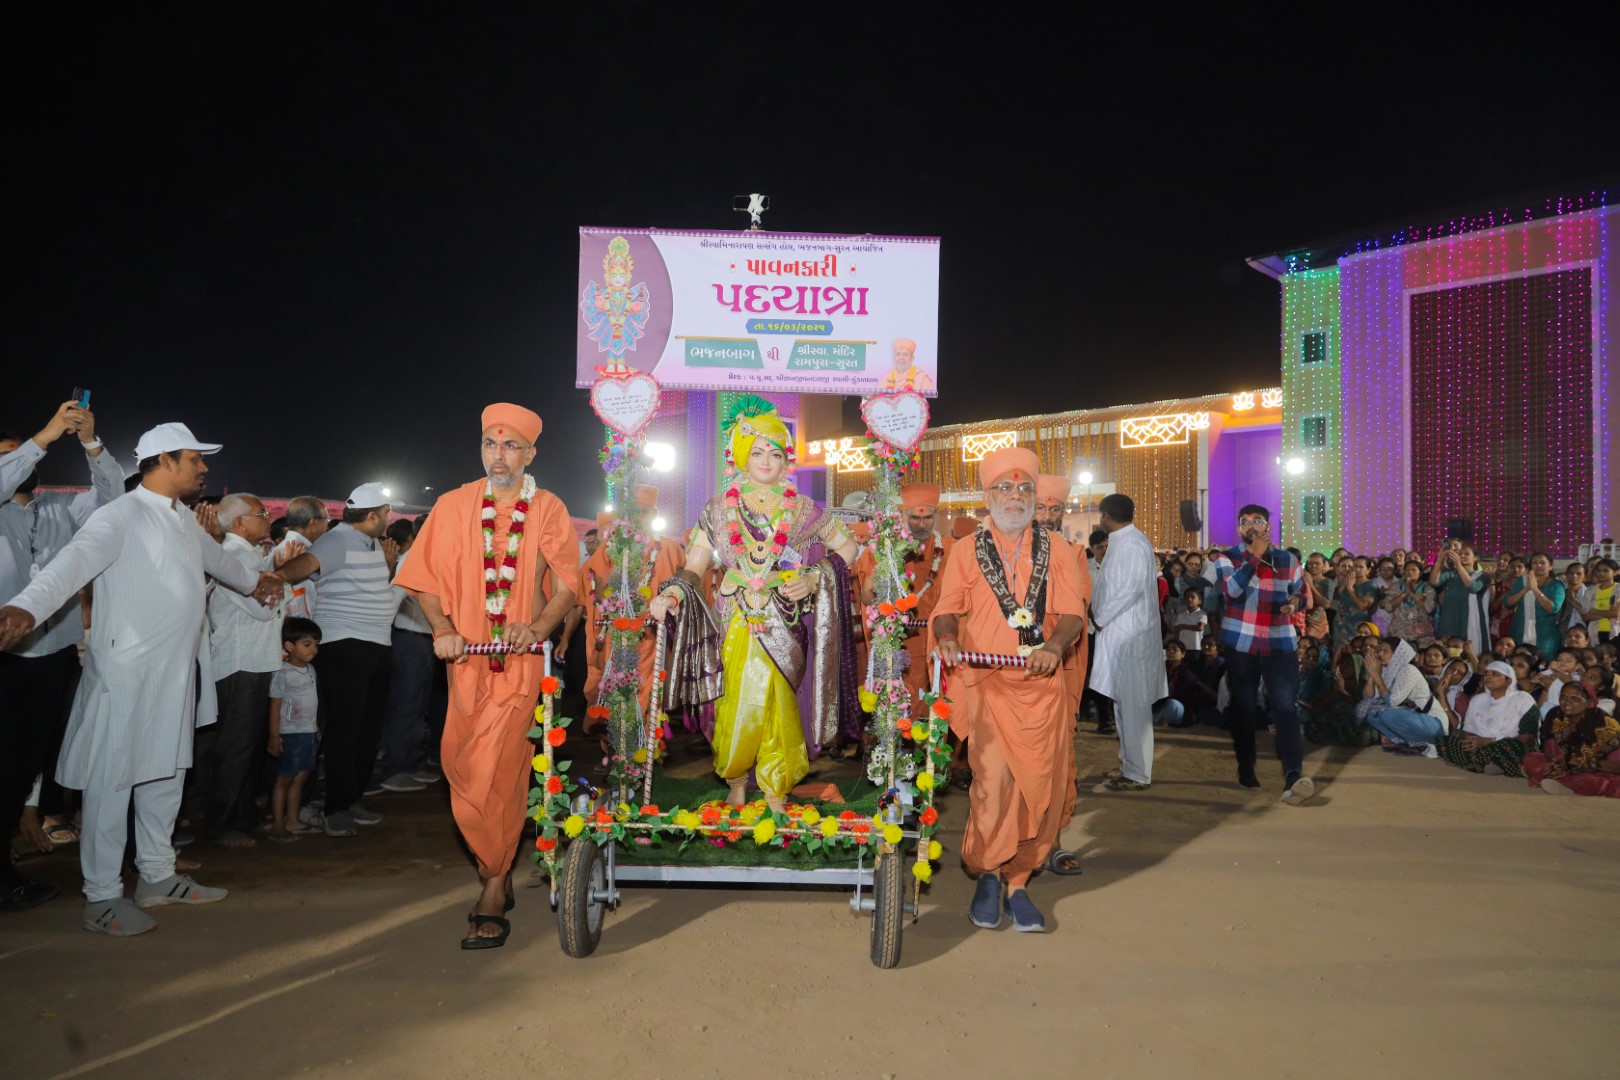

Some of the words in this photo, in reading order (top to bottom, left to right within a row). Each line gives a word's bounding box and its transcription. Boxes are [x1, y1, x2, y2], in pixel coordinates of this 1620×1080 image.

[746, 253, 837, 277] પાવનકારી
[711, 283, 869, 316] પદયાત્રા
[689, 346, 756, 360] ભજનબાગ
[766, 346, 780, 361] થી
[797, 343, 829, 356] શ્રીસ્વા.
[832, 344, 856, 357] મંદિર
